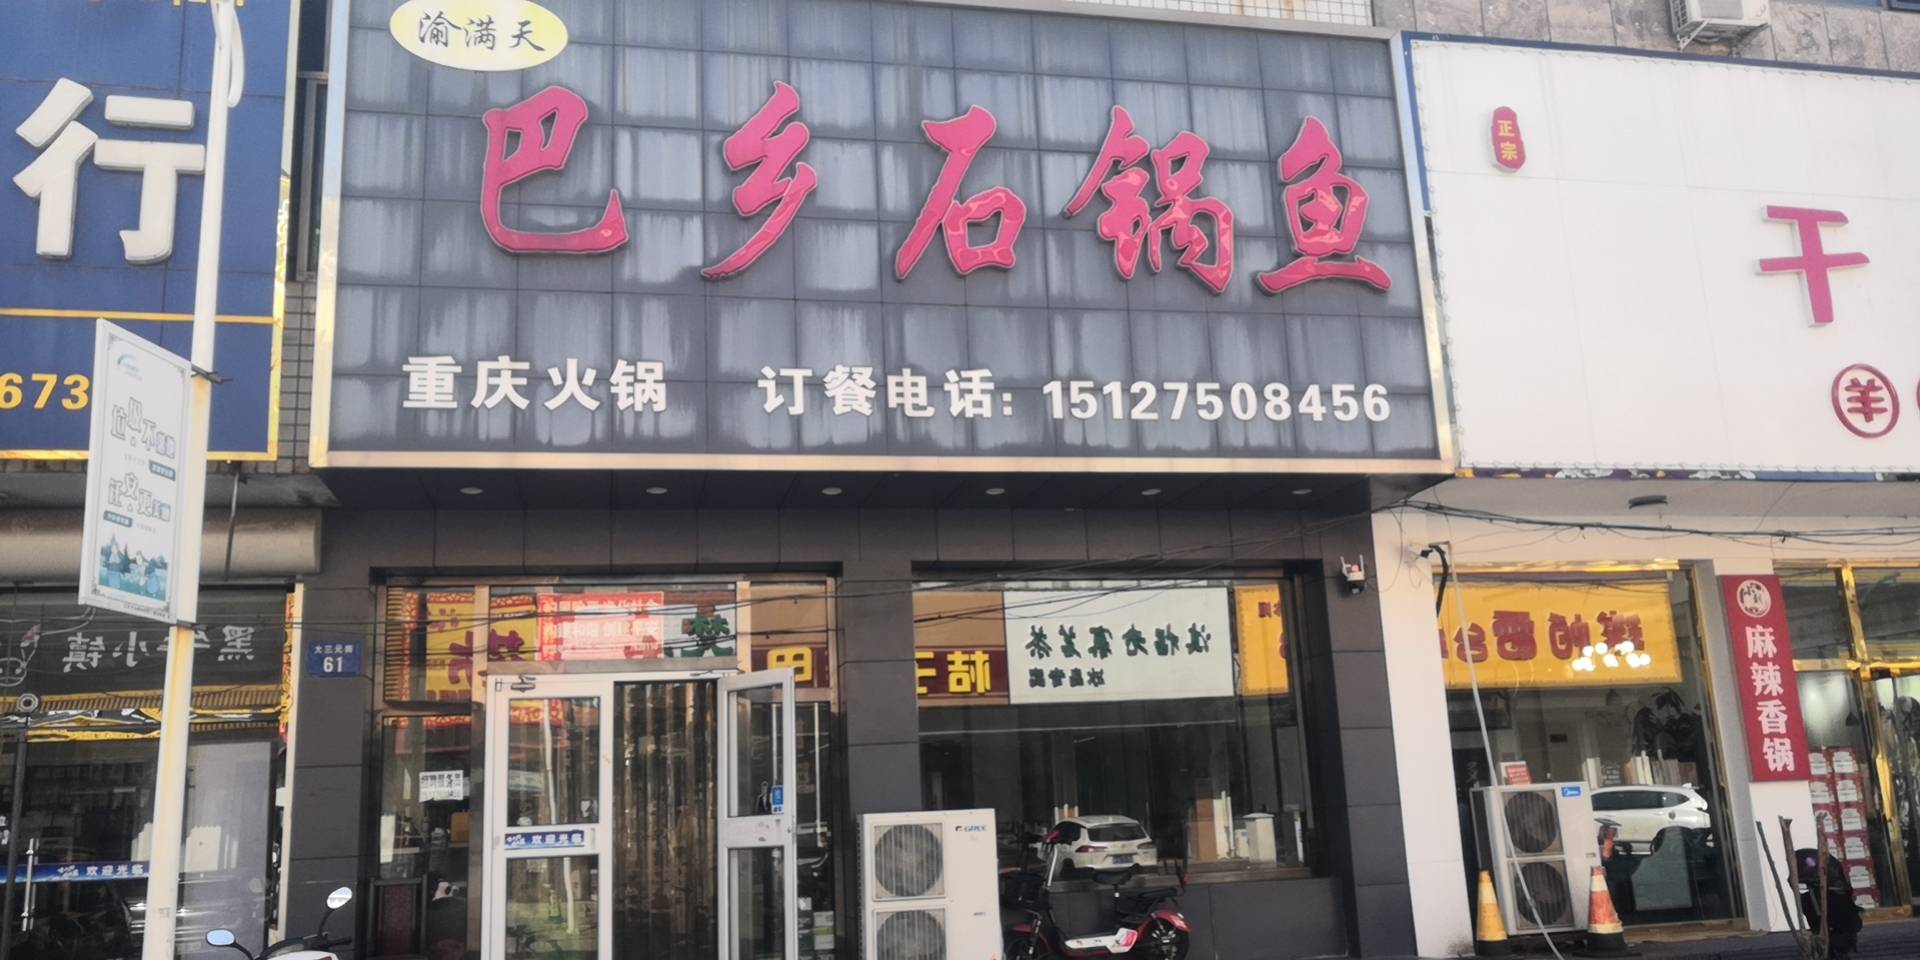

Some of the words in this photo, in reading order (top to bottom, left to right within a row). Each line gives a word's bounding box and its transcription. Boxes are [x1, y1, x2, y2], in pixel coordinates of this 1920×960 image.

[418, 10, 547, 52] 渝满天
[1496, 119, 1520, 161] 正宗
[12, 77, 206, 263] 行
[480, 80, 1394, 296] 巴乡石锅鱼
[1757, 204, 1871, 326] 干
[401, 354, 668, 413] 重庆火锅
[1042, 379, 1391, 423] 15127508456
[1844, 376, 1889, 423] 羊
[323, 656, 343, 673] 61
[1744, 624, 1795, 773] 麻辣香锅
[86, 864, 145, 877] 欢迎光临
